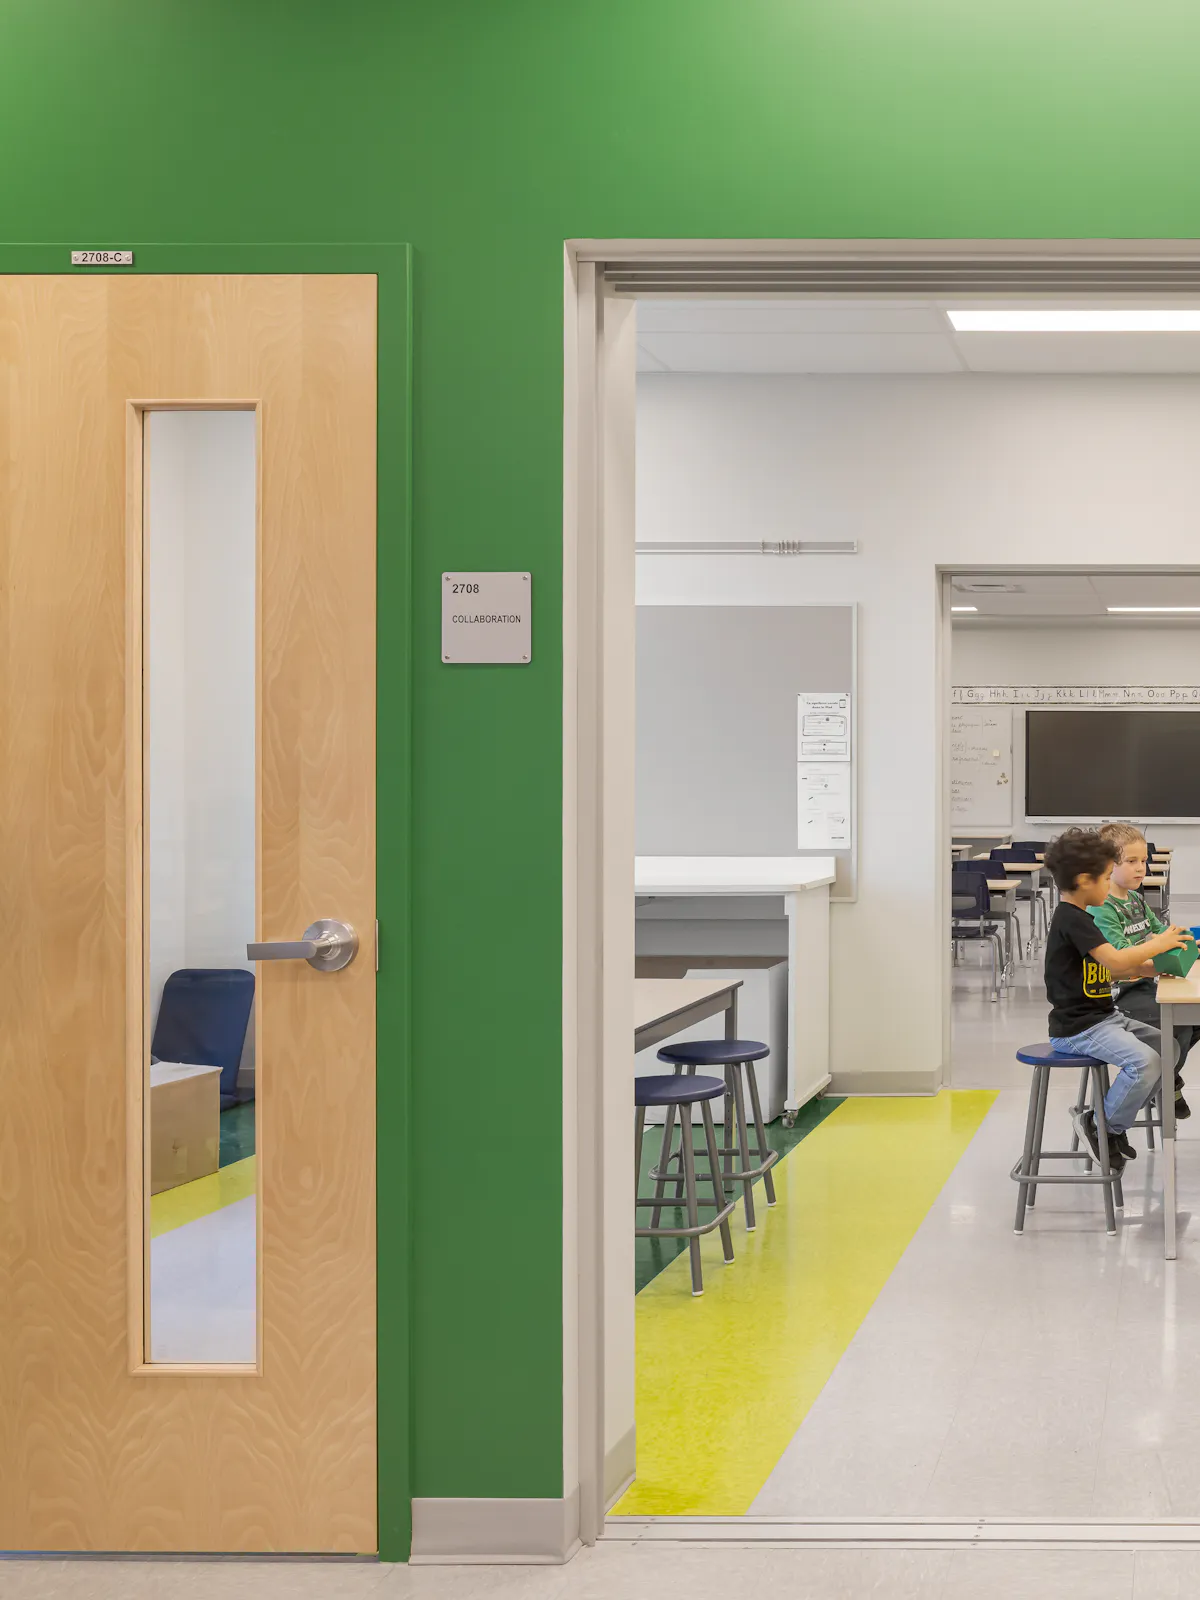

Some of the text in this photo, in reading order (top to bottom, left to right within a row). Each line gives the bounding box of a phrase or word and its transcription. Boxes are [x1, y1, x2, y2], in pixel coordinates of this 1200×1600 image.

[82, 252, 122, 262] 2708-C
[452, 584, 479, 593] 2708
[452, 615, 521, 624] COLLABORATION
